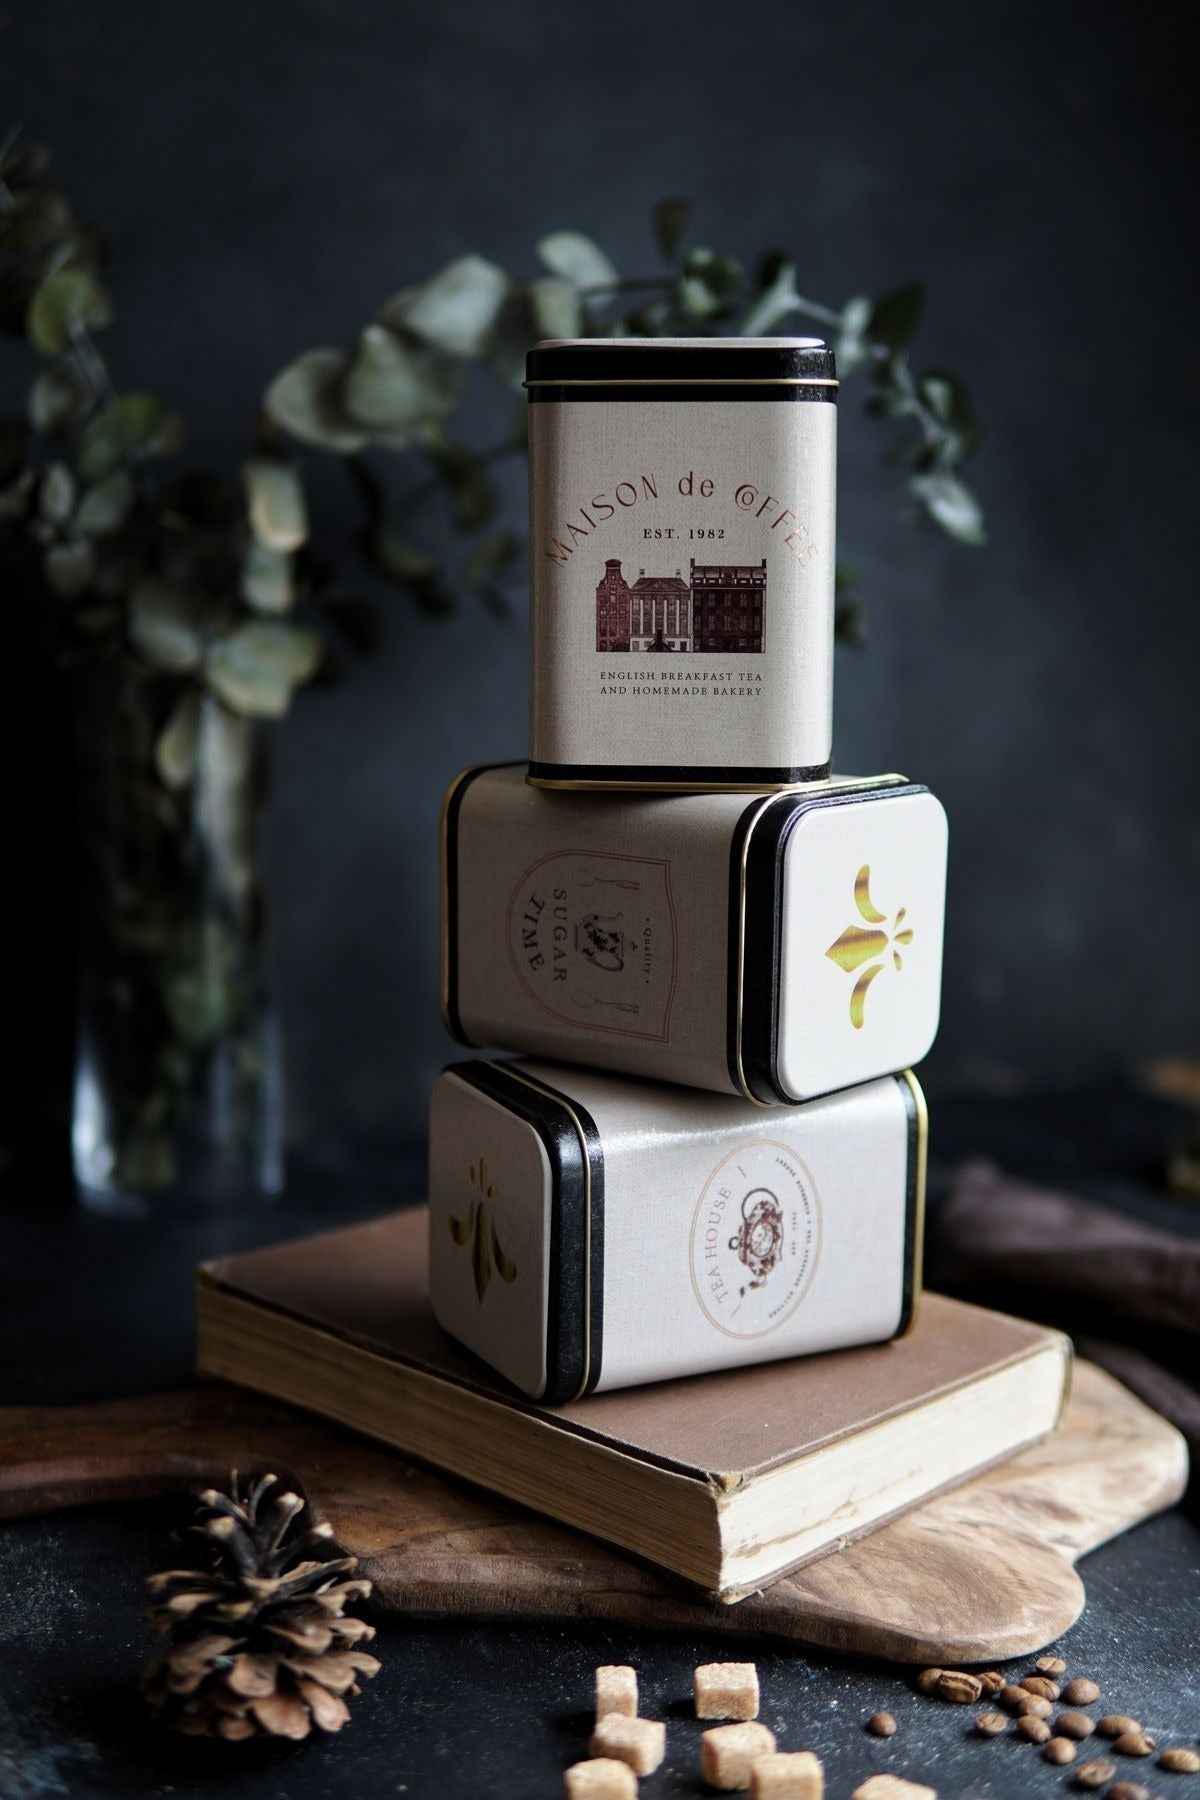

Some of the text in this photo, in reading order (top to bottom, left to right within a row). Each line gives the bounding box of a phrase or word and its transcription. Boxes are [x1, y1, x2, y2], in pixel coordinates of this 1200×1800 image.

[545, 473, 658, 568] MAISON
[678, 471, 715, 497] de
[643, 528, 725, 540] EST. 1982
[600, 672, 762, 681] ENGLISH BREAKFAST TEA
[600, 686, 763, 696] AND HOMEMADE BAKERY
[522, 891, 545, 971] TIME
[553, 888, 568, 983] SUGAR
[642, 927, 653, 975] Quality
[705, 1186, 732, 1304] TEA HOUSE
